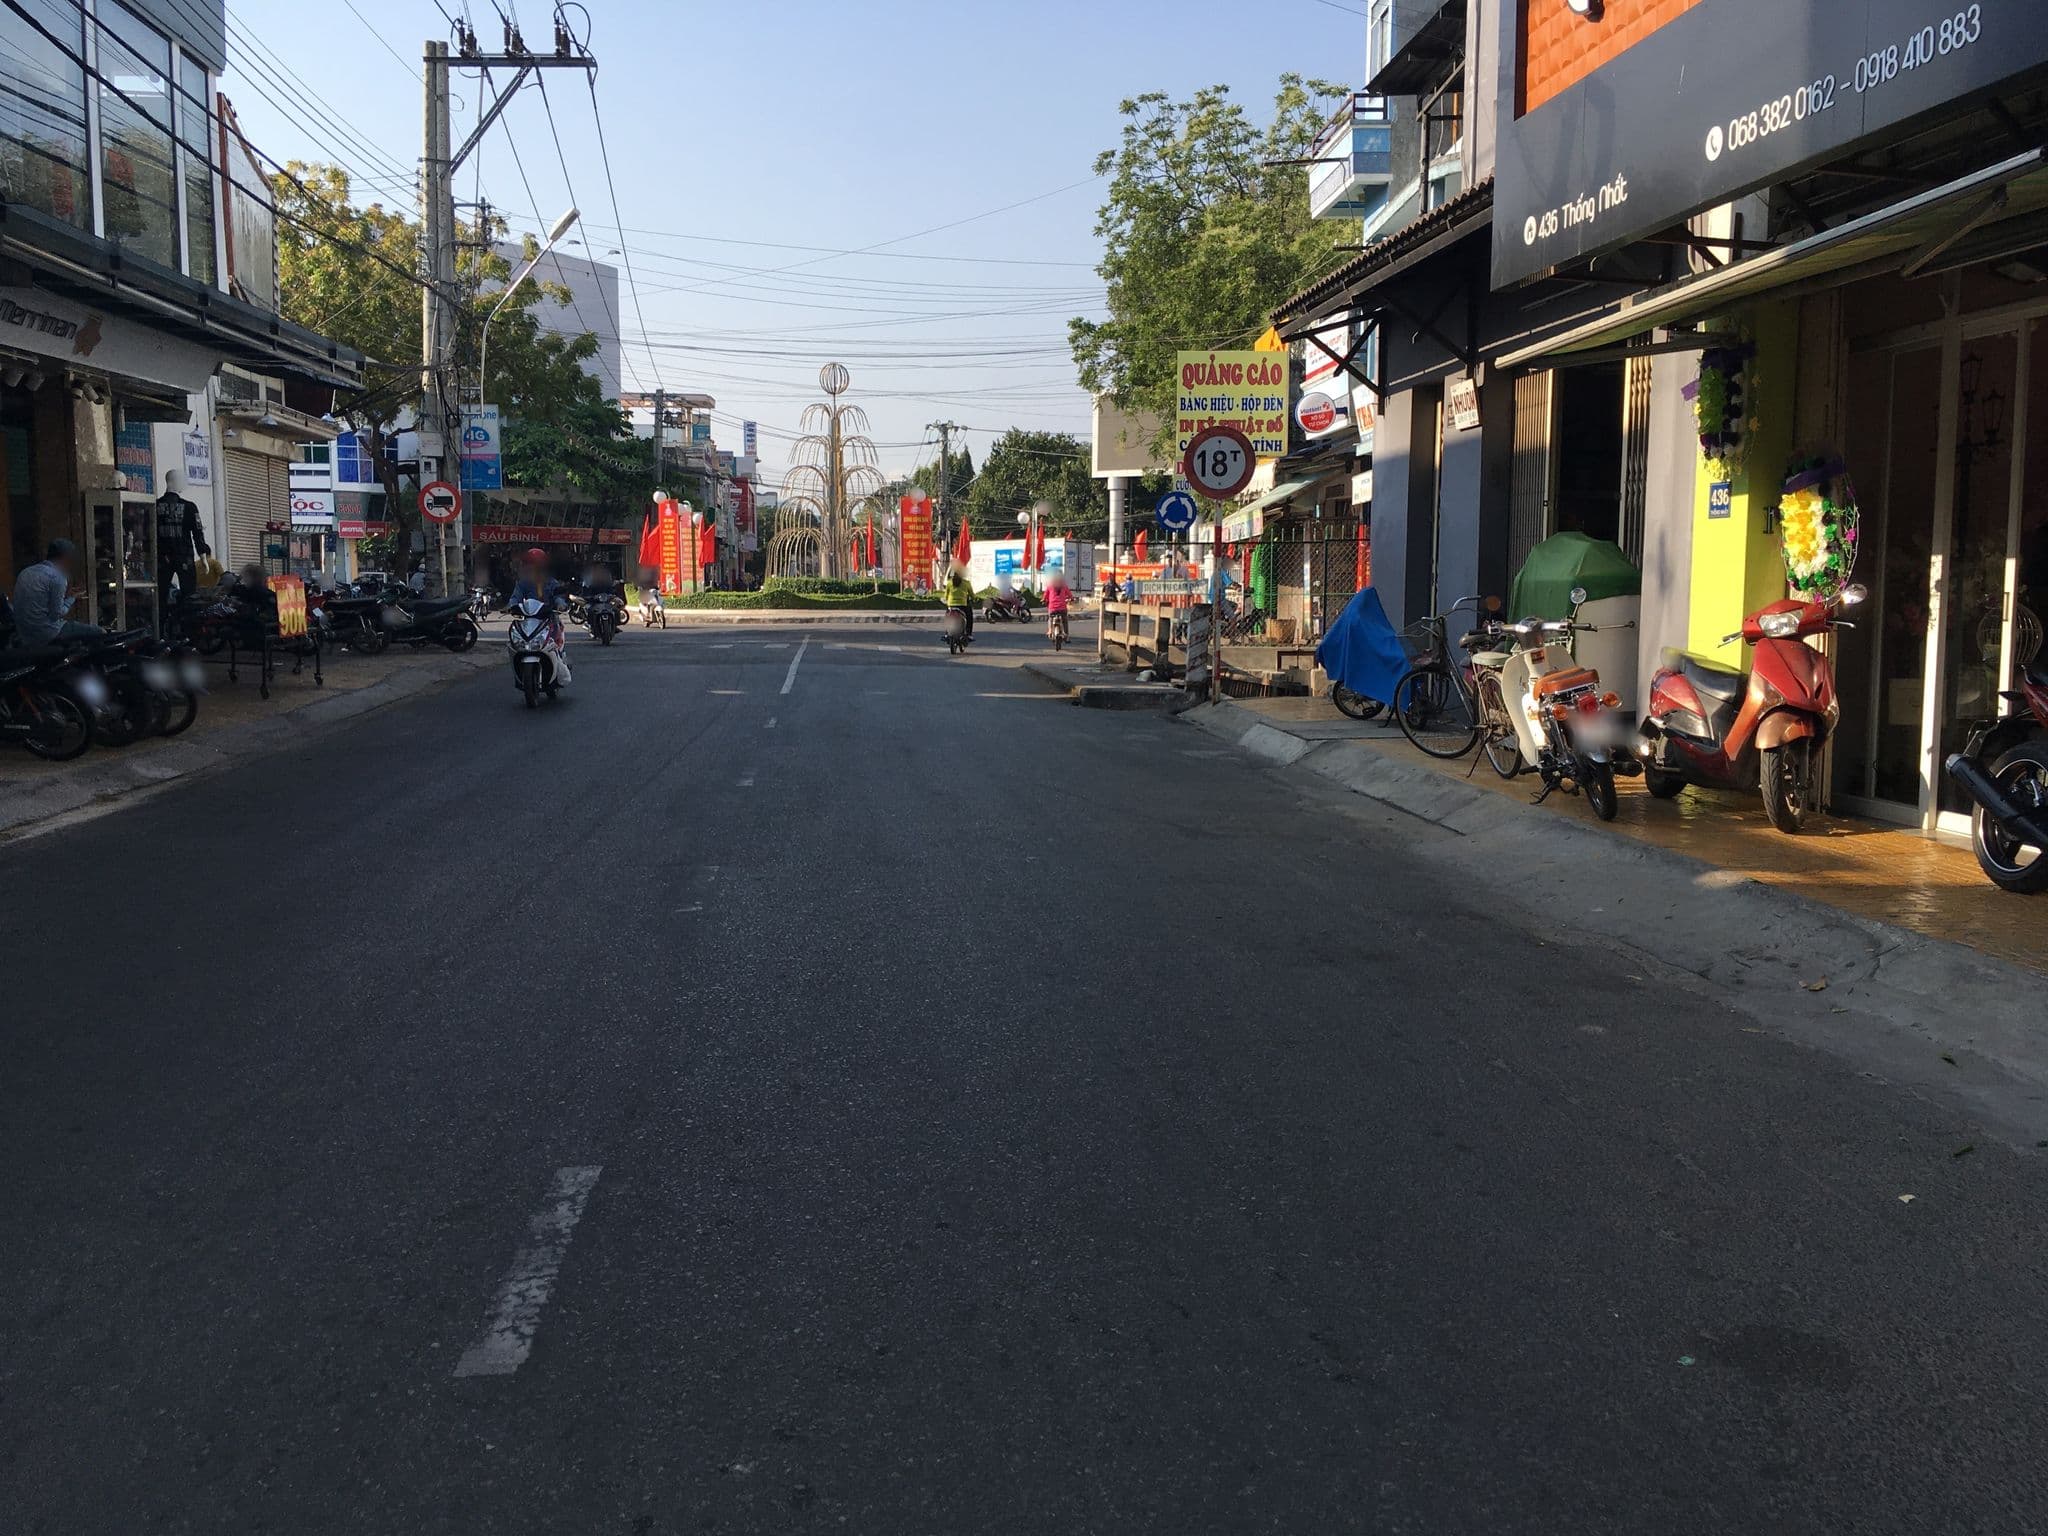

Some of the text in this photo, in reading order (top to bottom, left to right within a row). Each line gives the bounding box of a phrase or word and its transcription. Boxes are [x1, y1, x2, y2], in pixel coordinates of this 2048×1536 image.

[1728, 111, 1757, 150] 068
[1759, 95, 1791, 136] 382
[1795, 75, 1835, 120] 0162
[1855, 44, 1898, 94] 0918
[1901, 26, 1935, 71] 410
[1939, 3, 1981, 54] 883
[1538, 209, 1558, 238] 436
[1562, 192, 1595, 228] Thống
[1182, 354, 1282, 390] QUẢNG CÁO
[1180, 391, 1207, 411] BẢNG
[1210, 394, 1234, 414] HIỆU
[1242, 394, 1261, 414] HỘP
[1179, 420, 1194, 432] IN
[1711, 489, 1729, 506] 436
